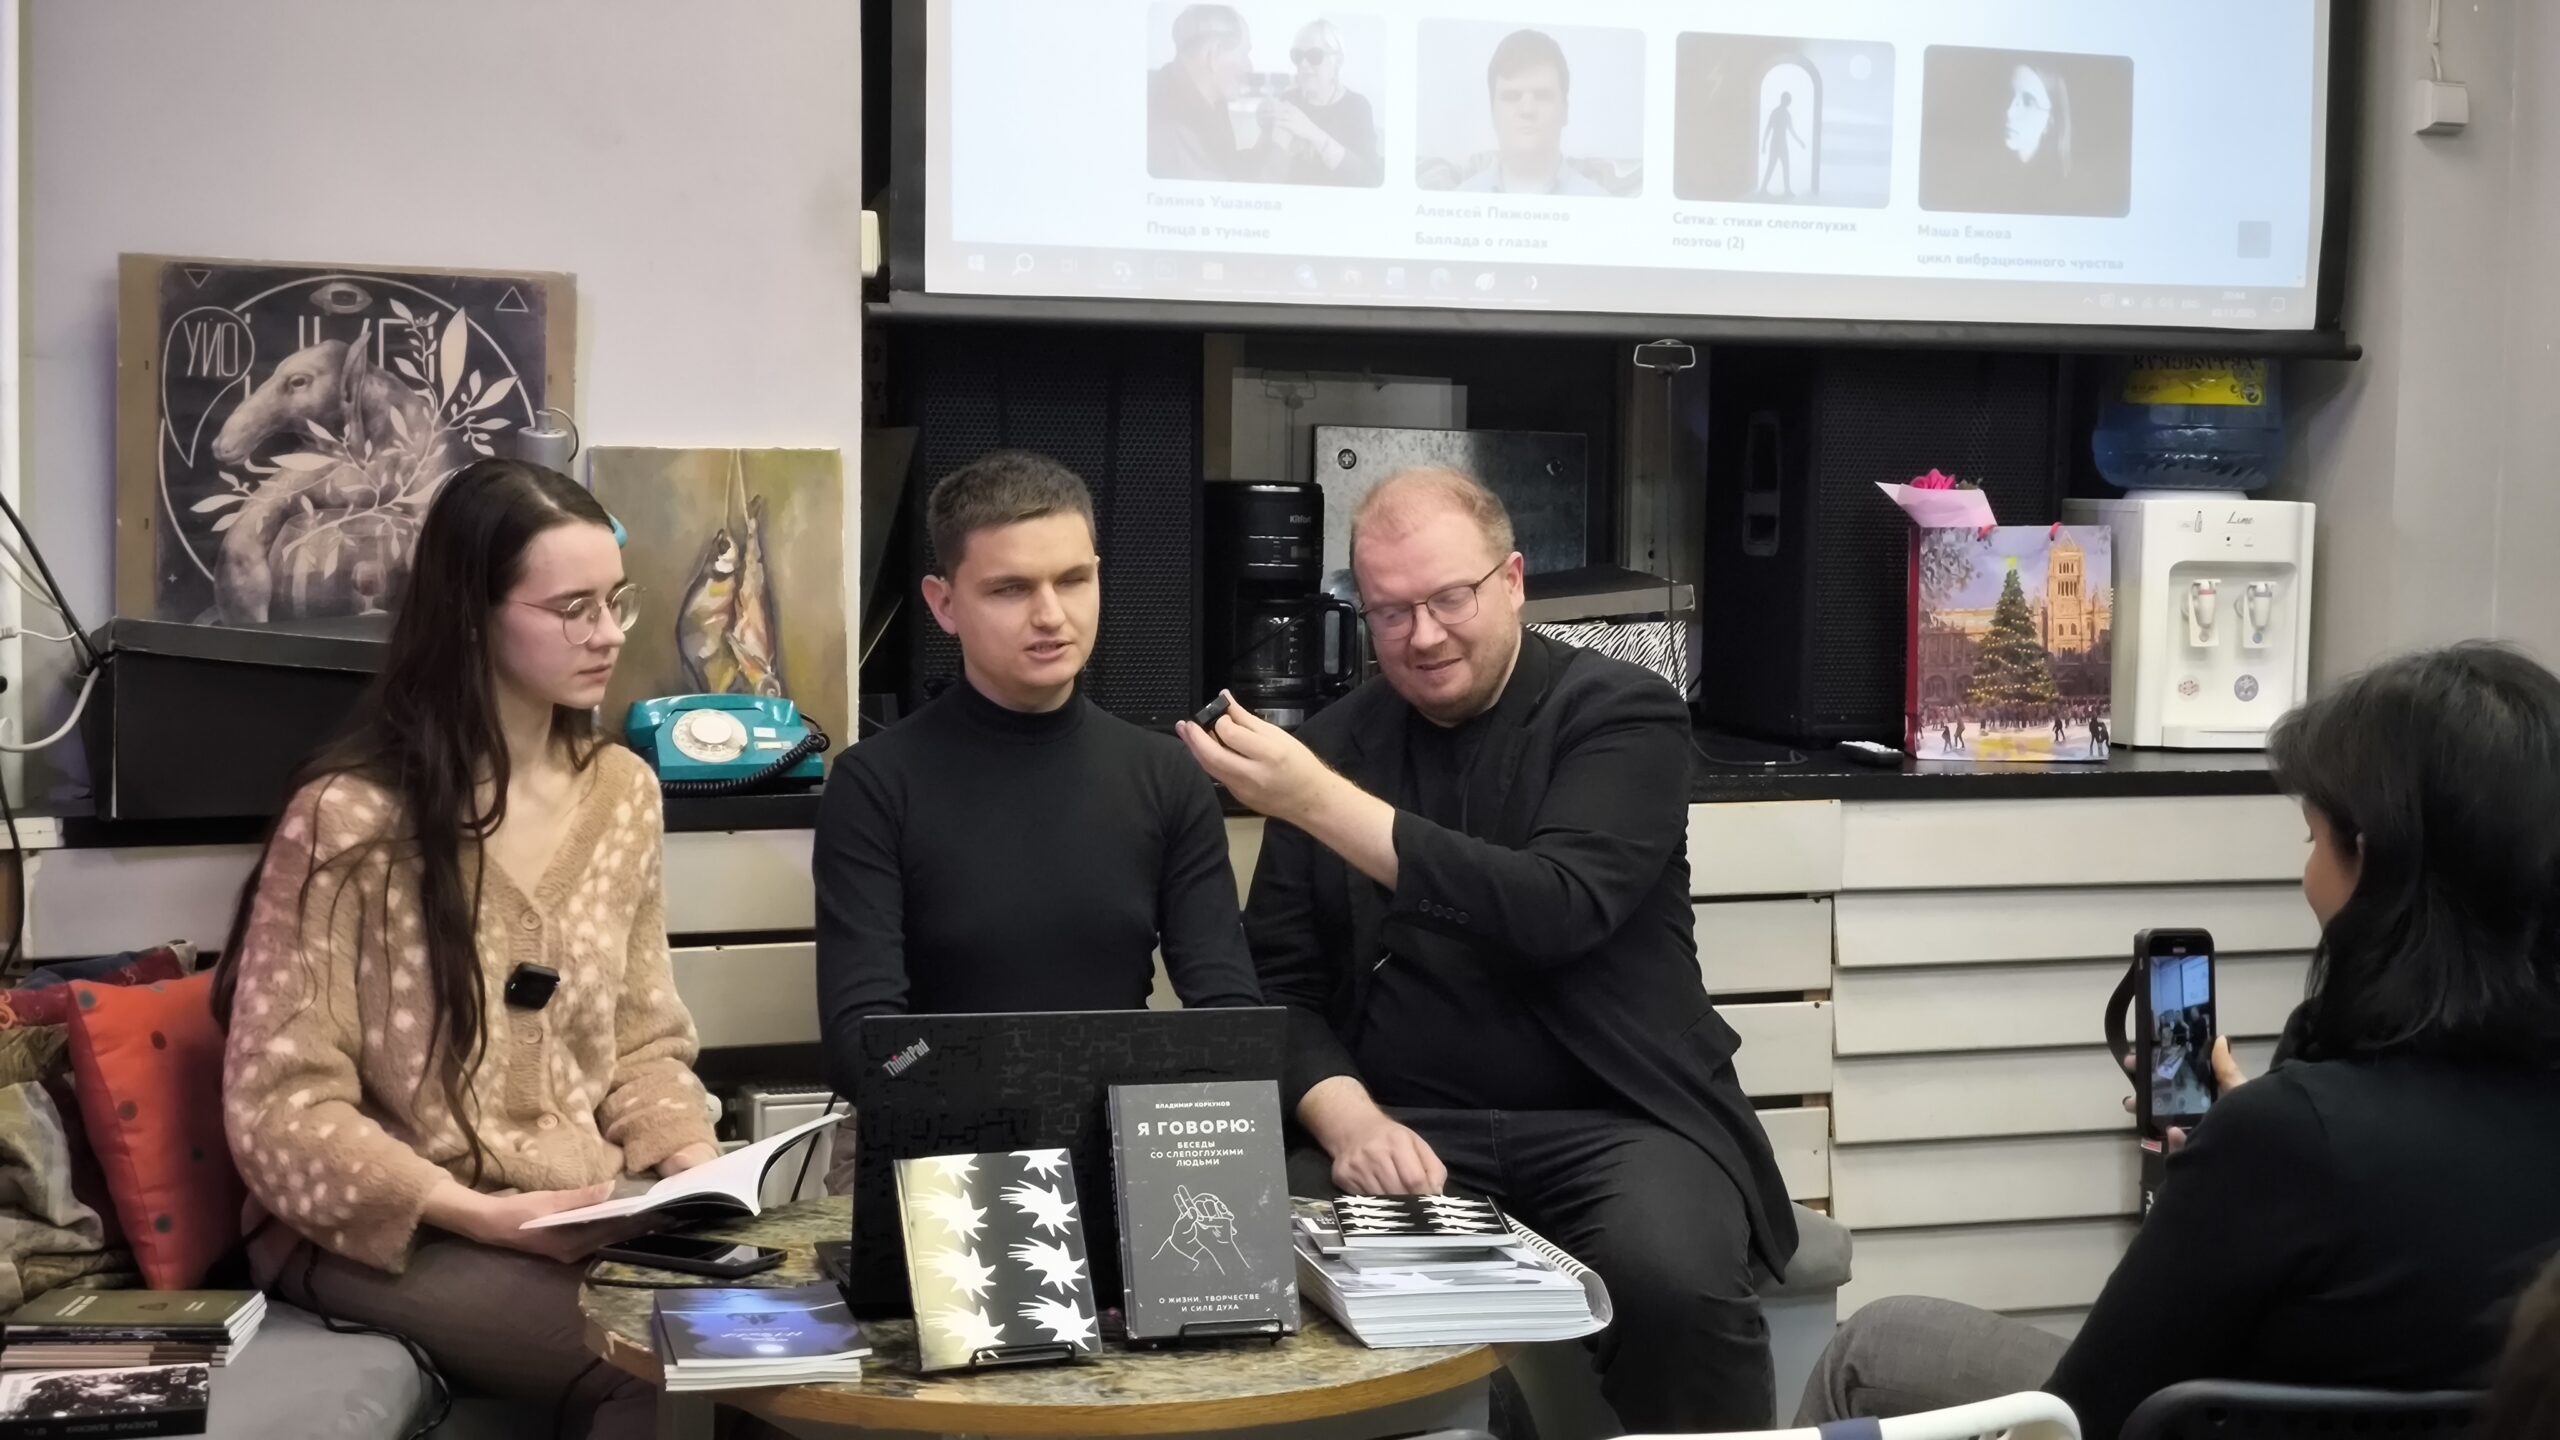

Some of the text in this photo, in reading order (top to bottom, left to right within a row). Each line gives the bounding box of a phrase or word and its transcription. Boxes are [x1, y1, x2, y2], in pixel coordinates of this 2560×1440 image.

[1416, 204, 1481, 219] Алексей
[1672, 211, 1857, 233] Сетка: стихи слепоглухих
[1146, 220, 1271, 240] Птица в тумане
[1917, 224, 1960, 238] Маша
[1415, 231, 1549, 249] Баллада о глазах
[1672, 236, 1745, 251] поэтов (2)
[1917, 253, 2124, 270] цикл вибрационного чувства
[882, 1037, 931, 1077] ThinkPad
[1155, 1102, 1193, 1110] ВЛАДИМИР
[1137, 1119, 1256, 1136] Я ГОВОРЮ:
[1177, 1140, 1216, 1149] БЕСЕДЫ
[1150, 1148, 1244, 1159] СО СЛЕПОГЛУХИМИ
[1175, 1158, 1221, 1167] ЛЮДЬМИ
[1204, 1293, 1261, 1302] ТВОРЧЕСТВЕ
[1190, 1304, 1213, 1312] СИЛЕ
[1216, 1303, 1239, 1312] ДУХА
